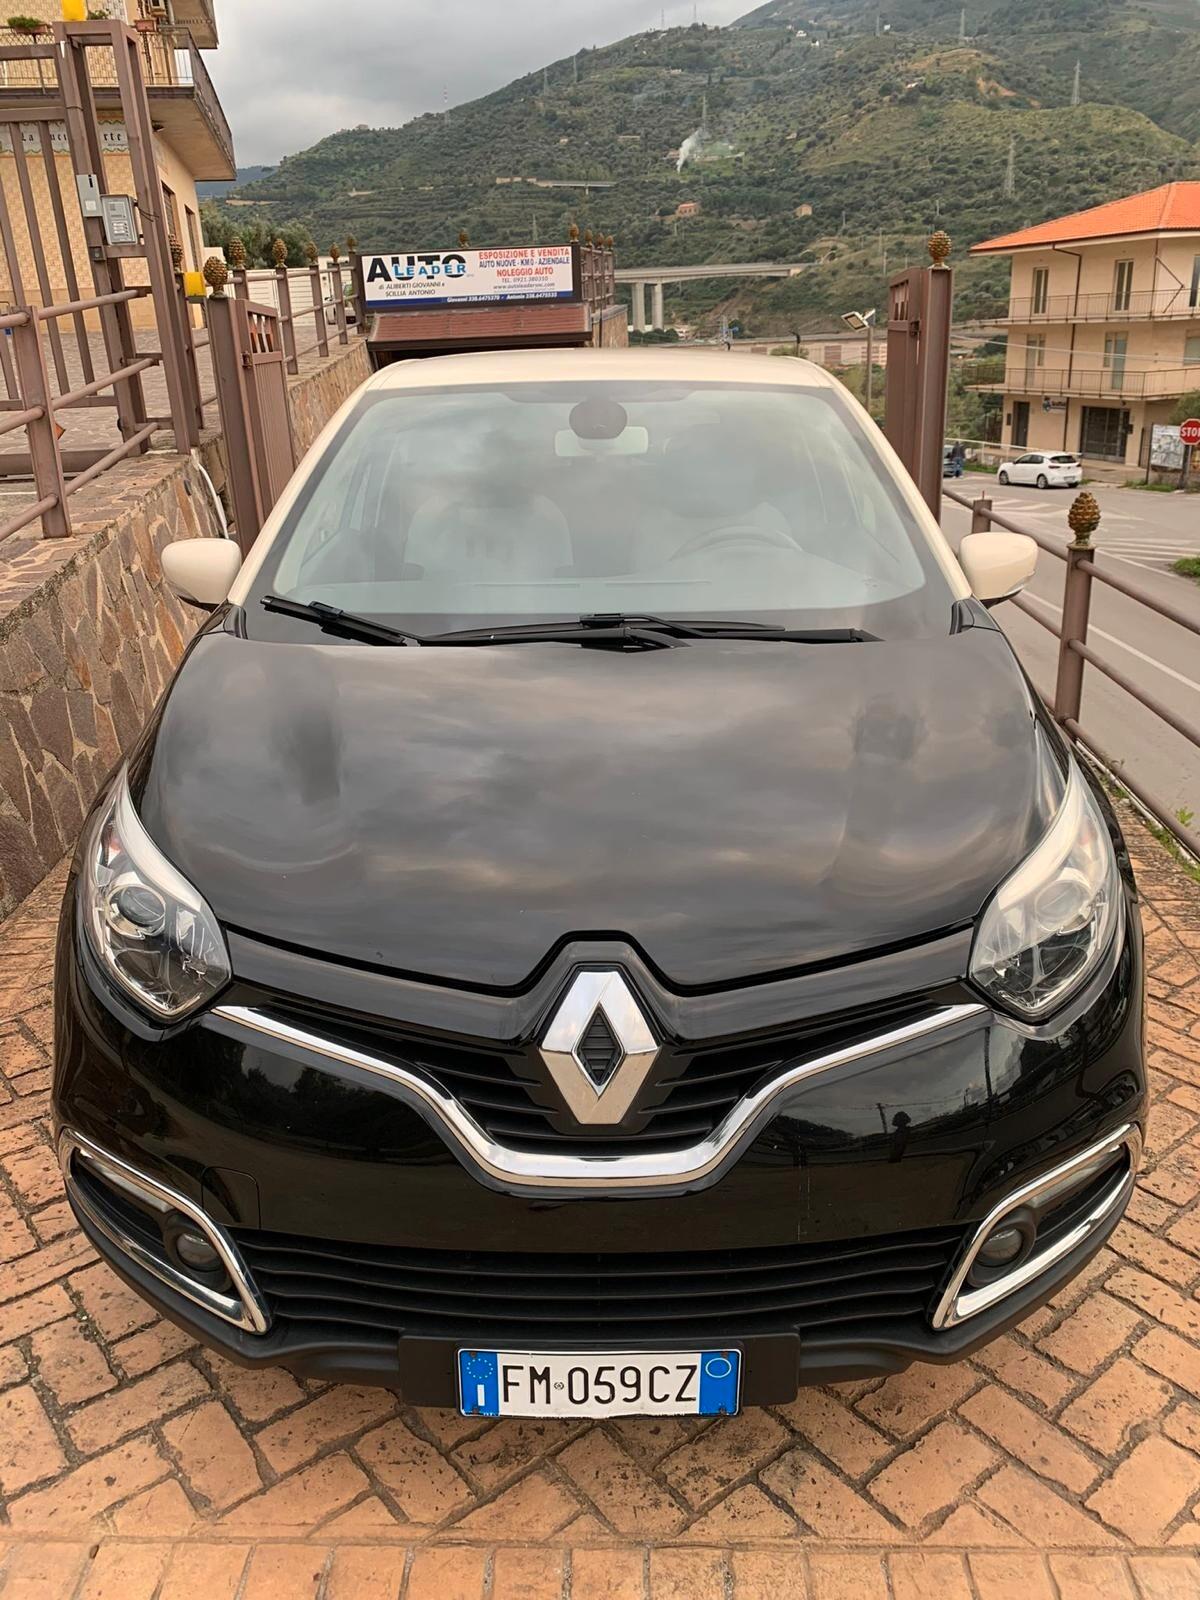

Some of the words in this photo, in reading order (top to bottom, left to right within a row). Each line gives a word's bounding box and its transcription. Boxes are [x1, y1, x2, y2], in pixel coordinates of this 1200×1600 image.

[479, 250, 528, 260] ESPOSIZIONE
[530, 249, 535, 257] E
[537, 247, 570, 256] VENDITA
[366, 253, 466, 282] AUTO
[479, 260, 495, 268] AUTO
[496, 258, 517, 267] NUOVE
[538, 256, 570, 265] AZIENDALE
[394, 264, 466, 276] LEADER
[496, 269, 533, 277] NOLEGGIO
[534, 266, 554, 275] AUTO
